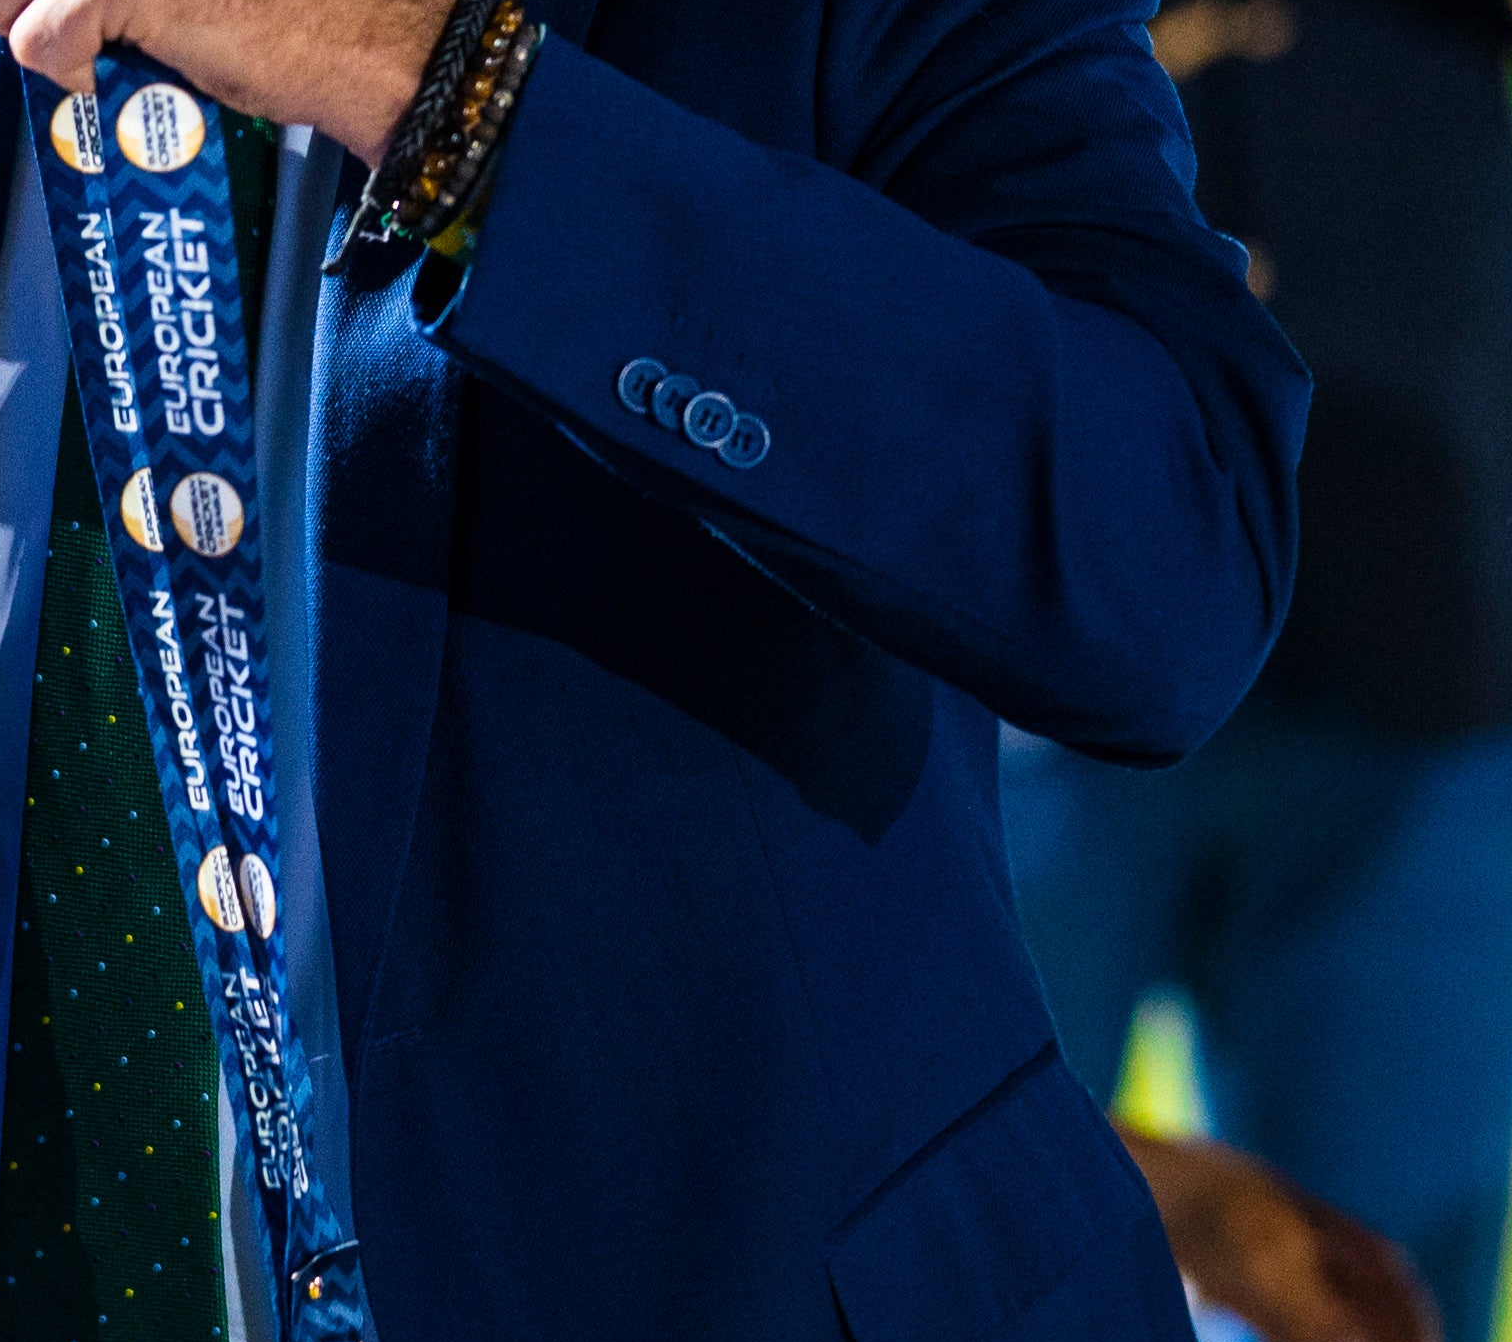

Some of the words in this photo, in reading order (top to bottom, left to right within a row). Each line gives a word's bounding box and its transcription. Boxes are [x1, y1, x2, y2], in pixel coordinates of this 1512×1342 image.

[78, 212, 138, 433] EUROPEAN
[139, 212, 191, 435] EUROPEAN
[170, 208, 225, 437] CRICKET
[149, 590, 210, 811] EUROPEAN
[195, 593, 245, 816] EUROPEAN
[219, 593, 264, 821] CRICKET
[222, 972, 281, 1189] EUROPEAN
